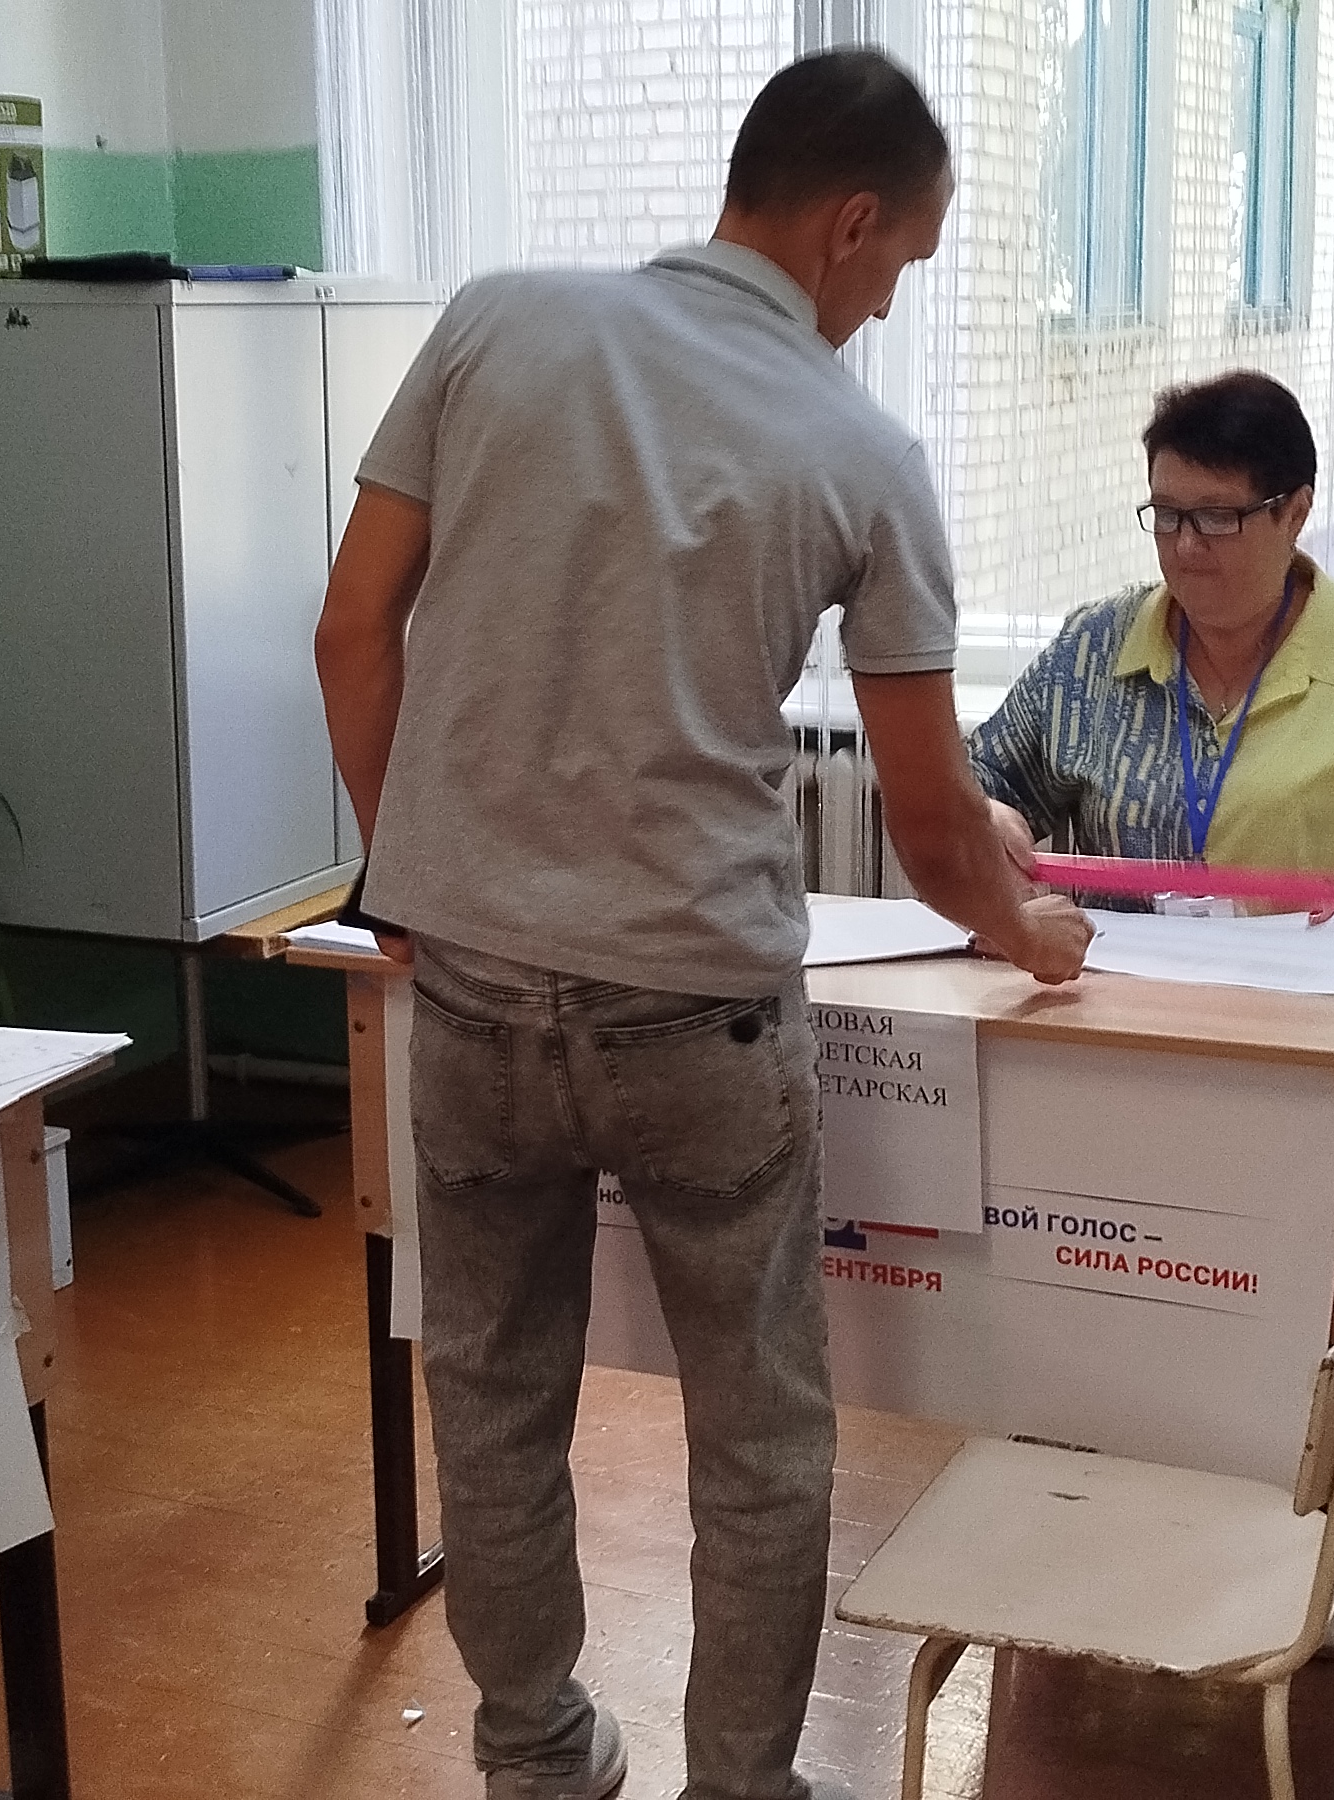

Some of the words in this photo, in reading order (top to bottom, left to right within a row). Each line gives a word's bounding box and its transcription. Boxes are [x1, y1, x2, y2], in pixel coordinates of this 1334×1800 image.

[820, 1041, 923, 1071] ЕТСКАЯ
[982, 1204, 1039, 1231] ВОЙ
[1047, 1213, 1137, 1244] ГОЛОС
[1056, 1245, 1130, 1274] СИЛА
[1138, 1257, 1259, 1294] РОССИИ!
